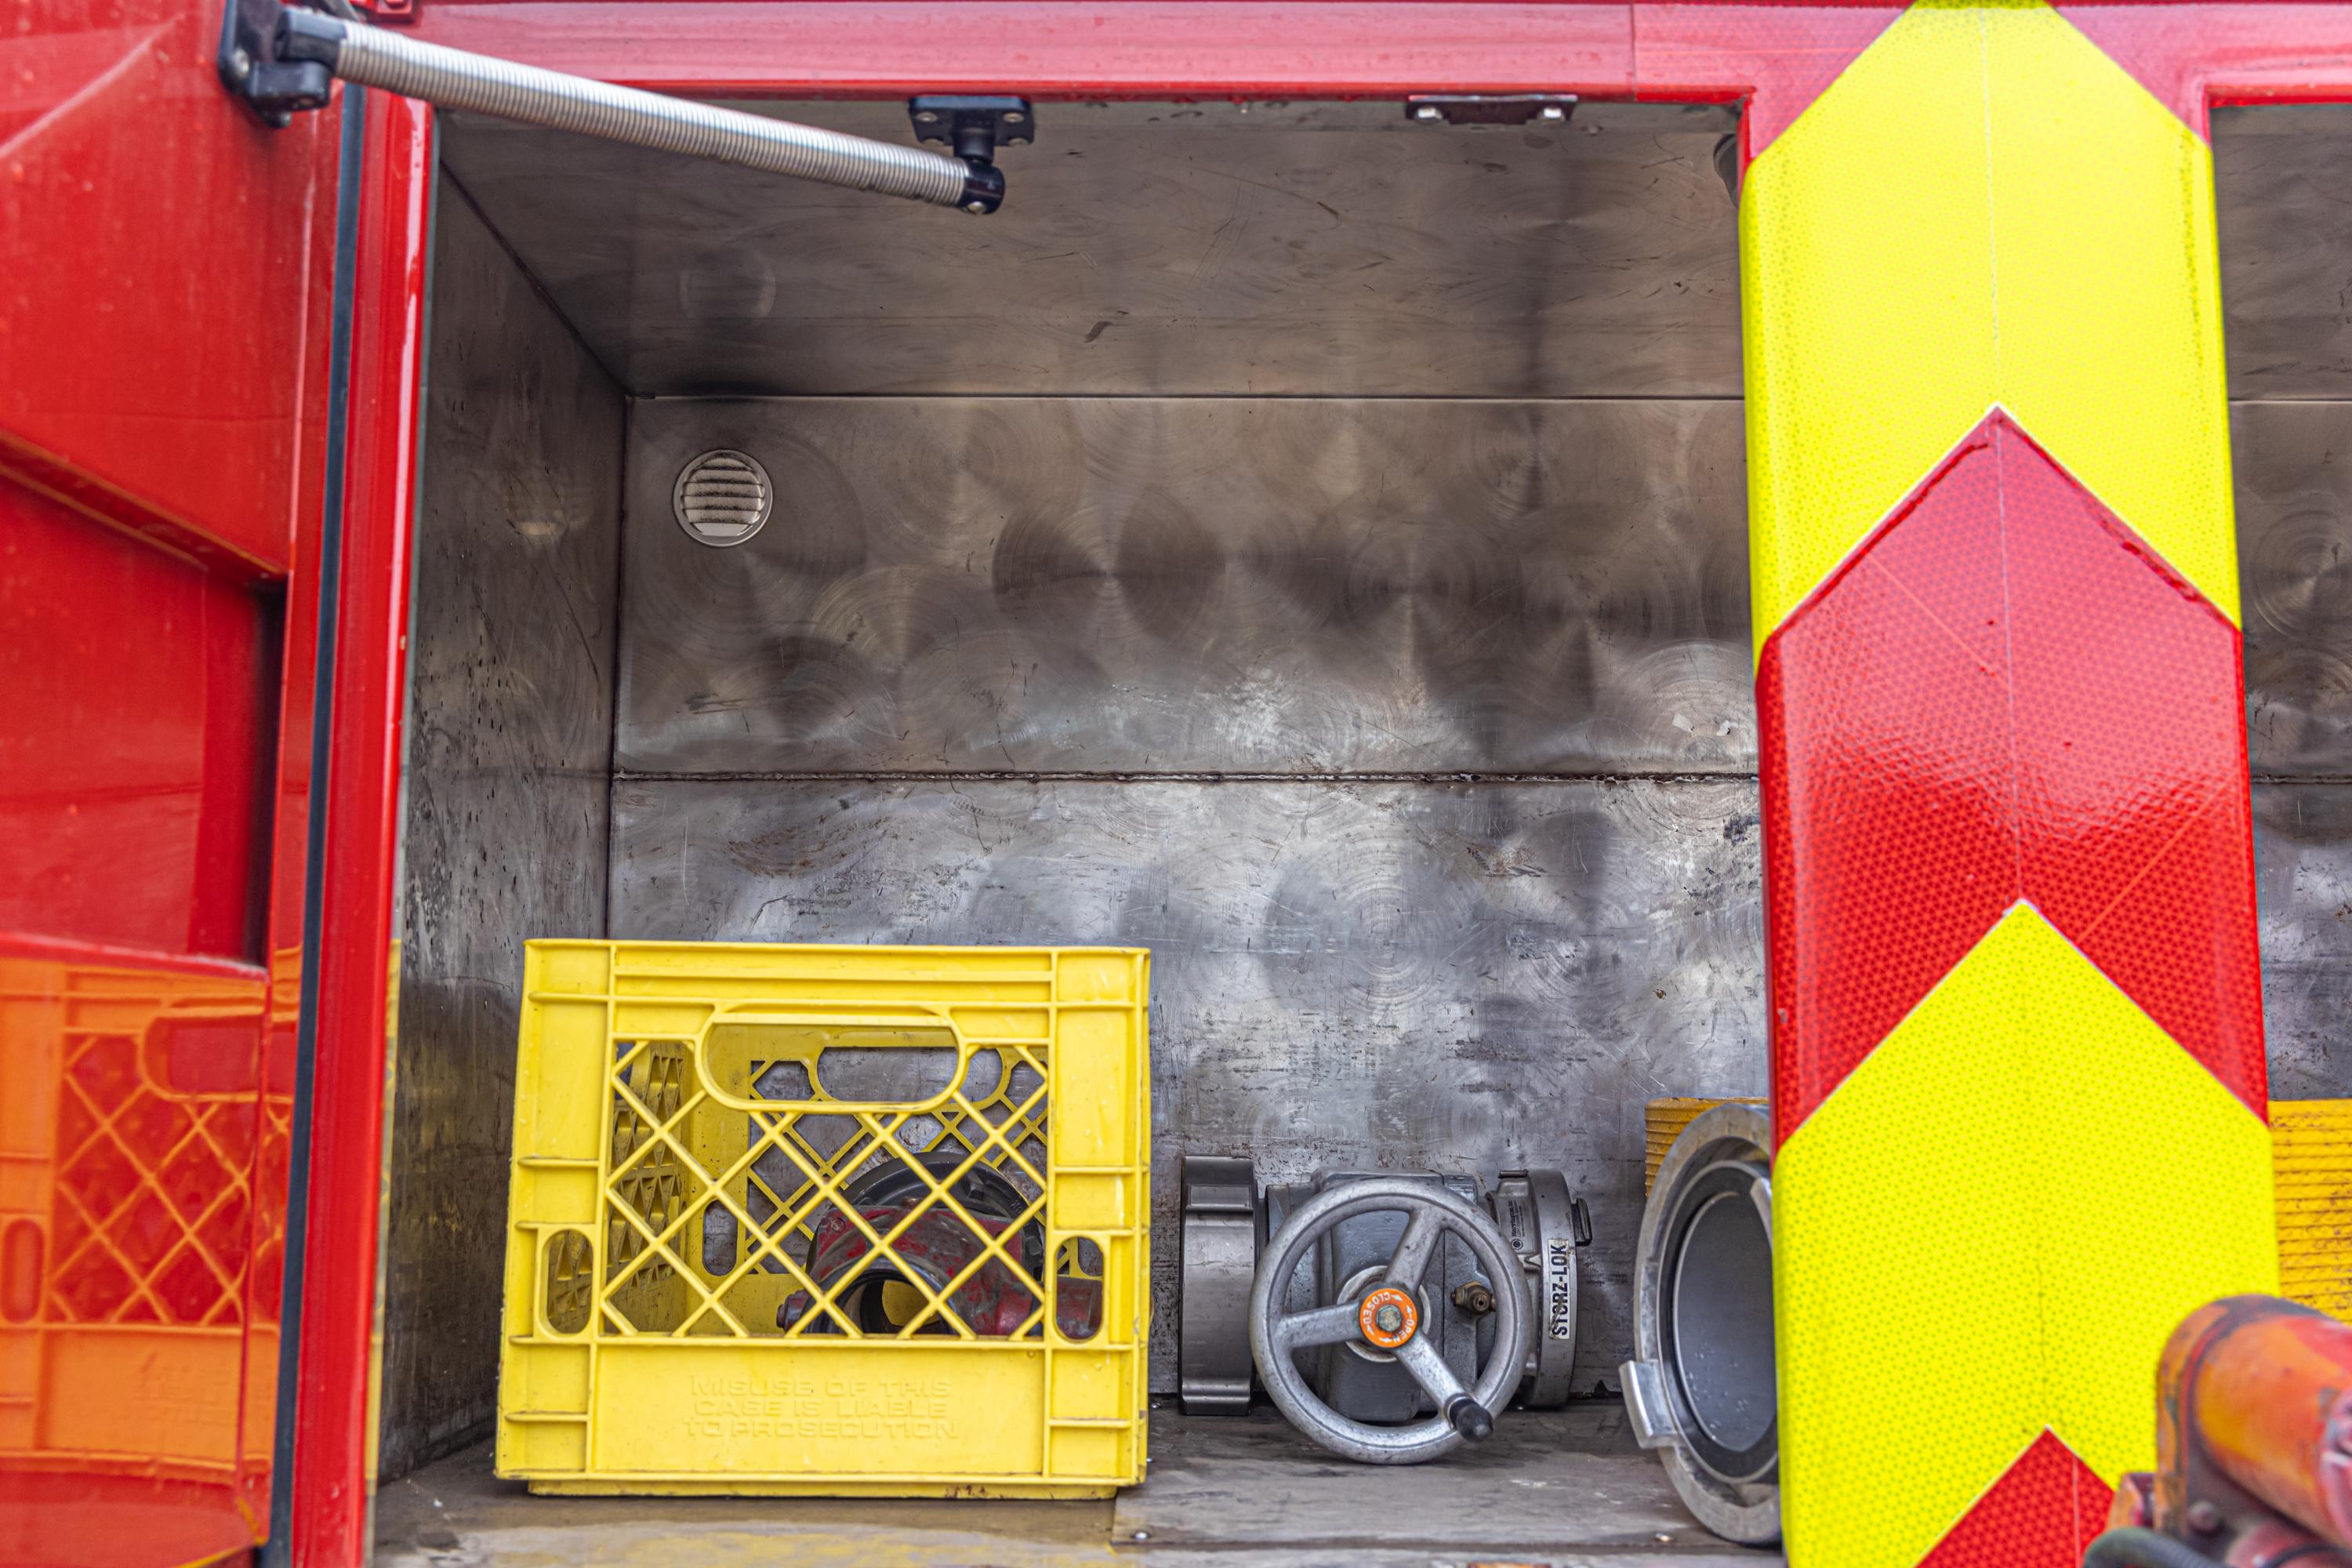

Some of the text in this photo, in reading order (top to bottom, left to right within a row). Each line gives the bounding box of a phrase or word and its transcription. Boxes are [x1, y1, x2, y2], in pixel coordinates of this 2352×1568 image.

[1550, 1244, 1568, 1336] STORZ-LOK
[1363, 1291, 1391, 1325] CLOSED
[1392, 1318, 1414, 1344] OPEN
[691, 1377, 951, 1398] MISUSE OF THIS
[695, 1398, 948, 1418] CASE IS LIABLE
[683, 1417, 958, 1439] TO PROSECUTION
